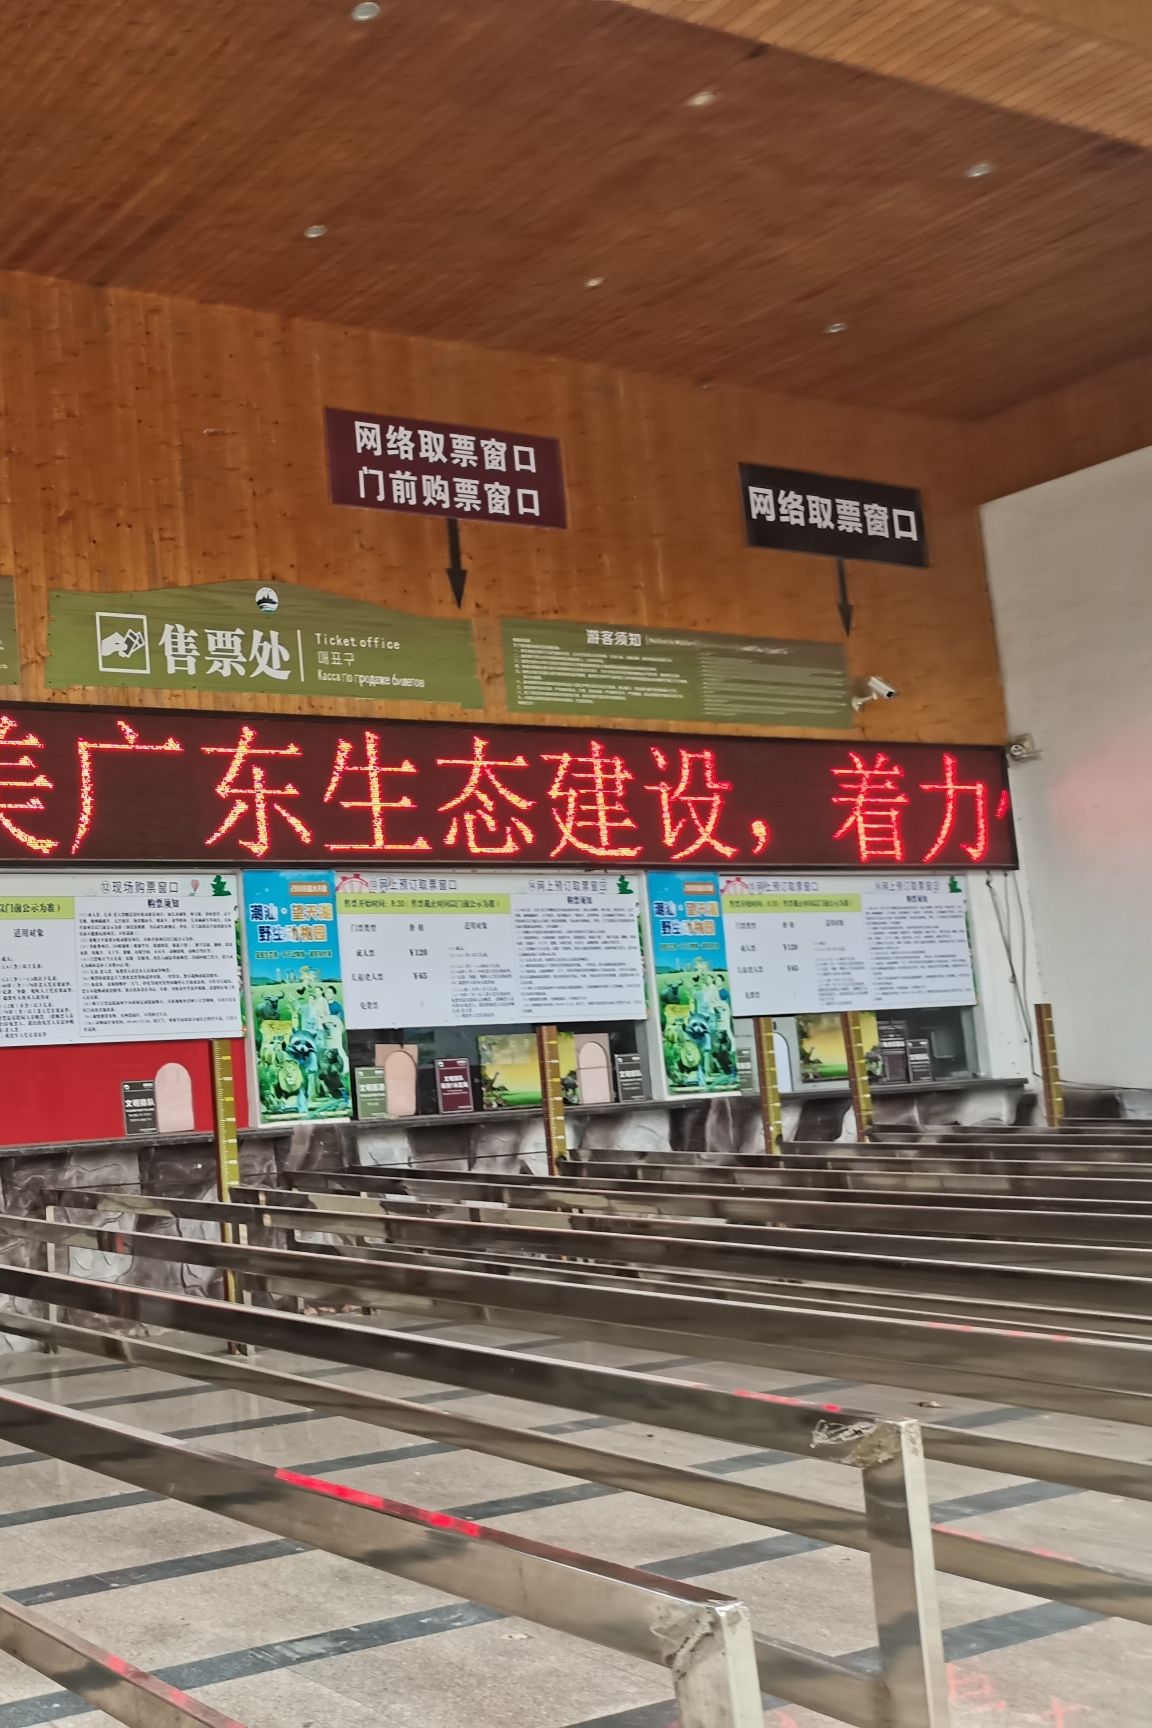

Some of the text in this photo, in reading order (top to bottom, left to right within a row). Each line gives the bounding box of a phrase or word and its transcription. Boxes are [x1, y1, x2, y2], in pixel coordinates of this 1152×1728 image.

[354, 421, 537, 473] 网络取票窗口
[358, 466, 541, 517] 门前购票窗口
[748, 485, 918, 541] 网络取票窗口
[159, 623, 291, 681] 售票处
[315, 633, 400, 650] Ticket office
[586, 629, 641, 647] 游客须知
